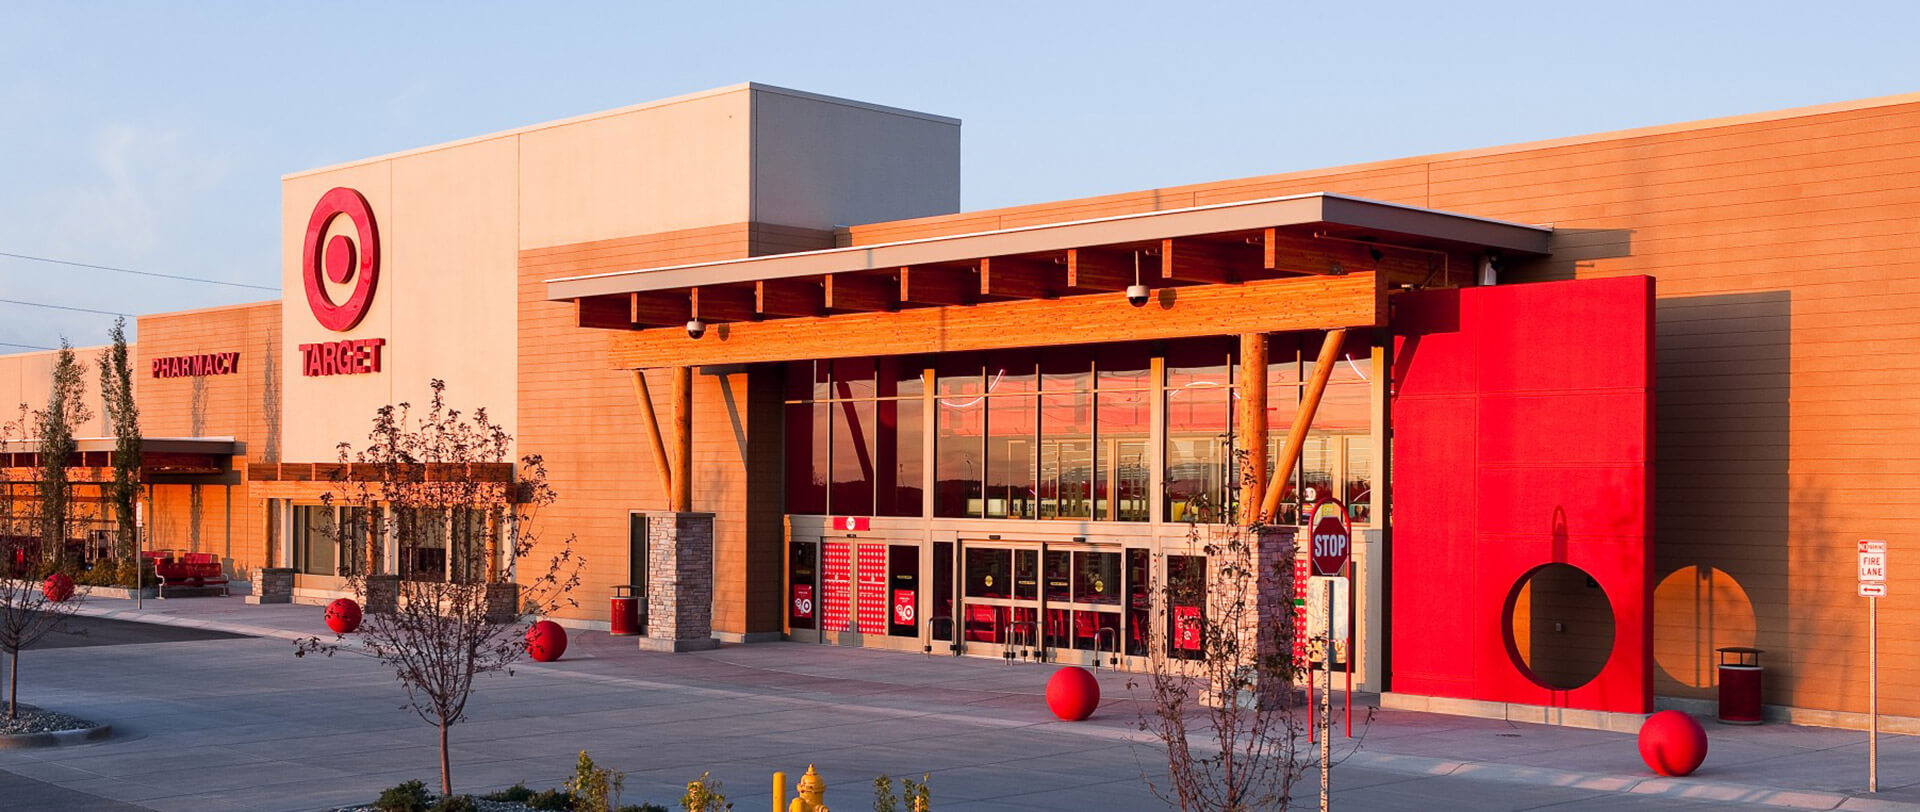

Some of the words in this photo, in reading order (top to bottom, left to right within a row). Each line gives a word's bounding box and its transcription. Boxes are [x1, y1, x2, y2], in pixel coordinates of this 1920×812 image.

[152, 352, 240, 379] PHARMACY
[298, 338, 386, 377] TARGET
[1314, 534, 1346, 557] STOP
[1862, 567, 1882, 576] LANE
[1863, 557, 1880, 566] FIRE
